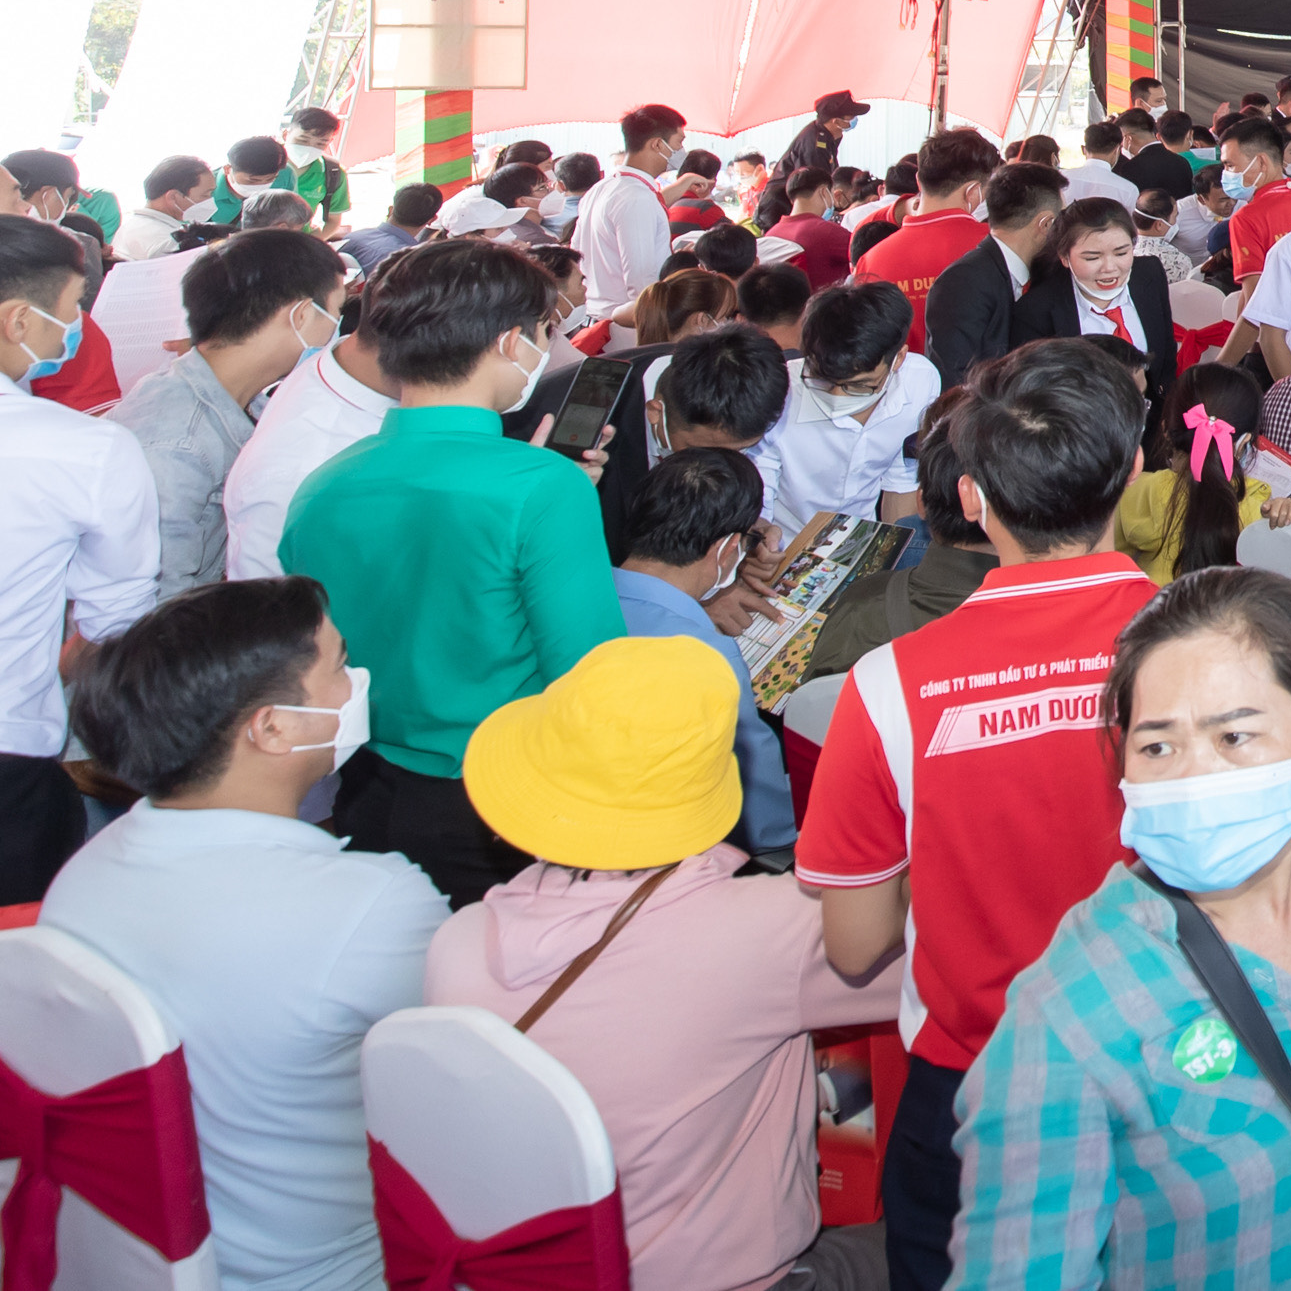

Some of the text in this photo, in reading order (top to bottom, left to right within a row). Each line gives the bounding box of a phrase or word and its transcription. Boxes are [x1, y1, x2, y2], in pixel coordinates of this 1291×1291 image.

[952, 676, 966, 692] TY
[967, 672, 996, 689] TNHH
[1023, 664, 1038, 680] TƯ
[1039, 664, 1047, 677] &
[1050, 657, 1077, 675] PHÁT
[979, 702, 1041, 738] NAM
[1182, 1038, 1232, 1079] TS1-3
